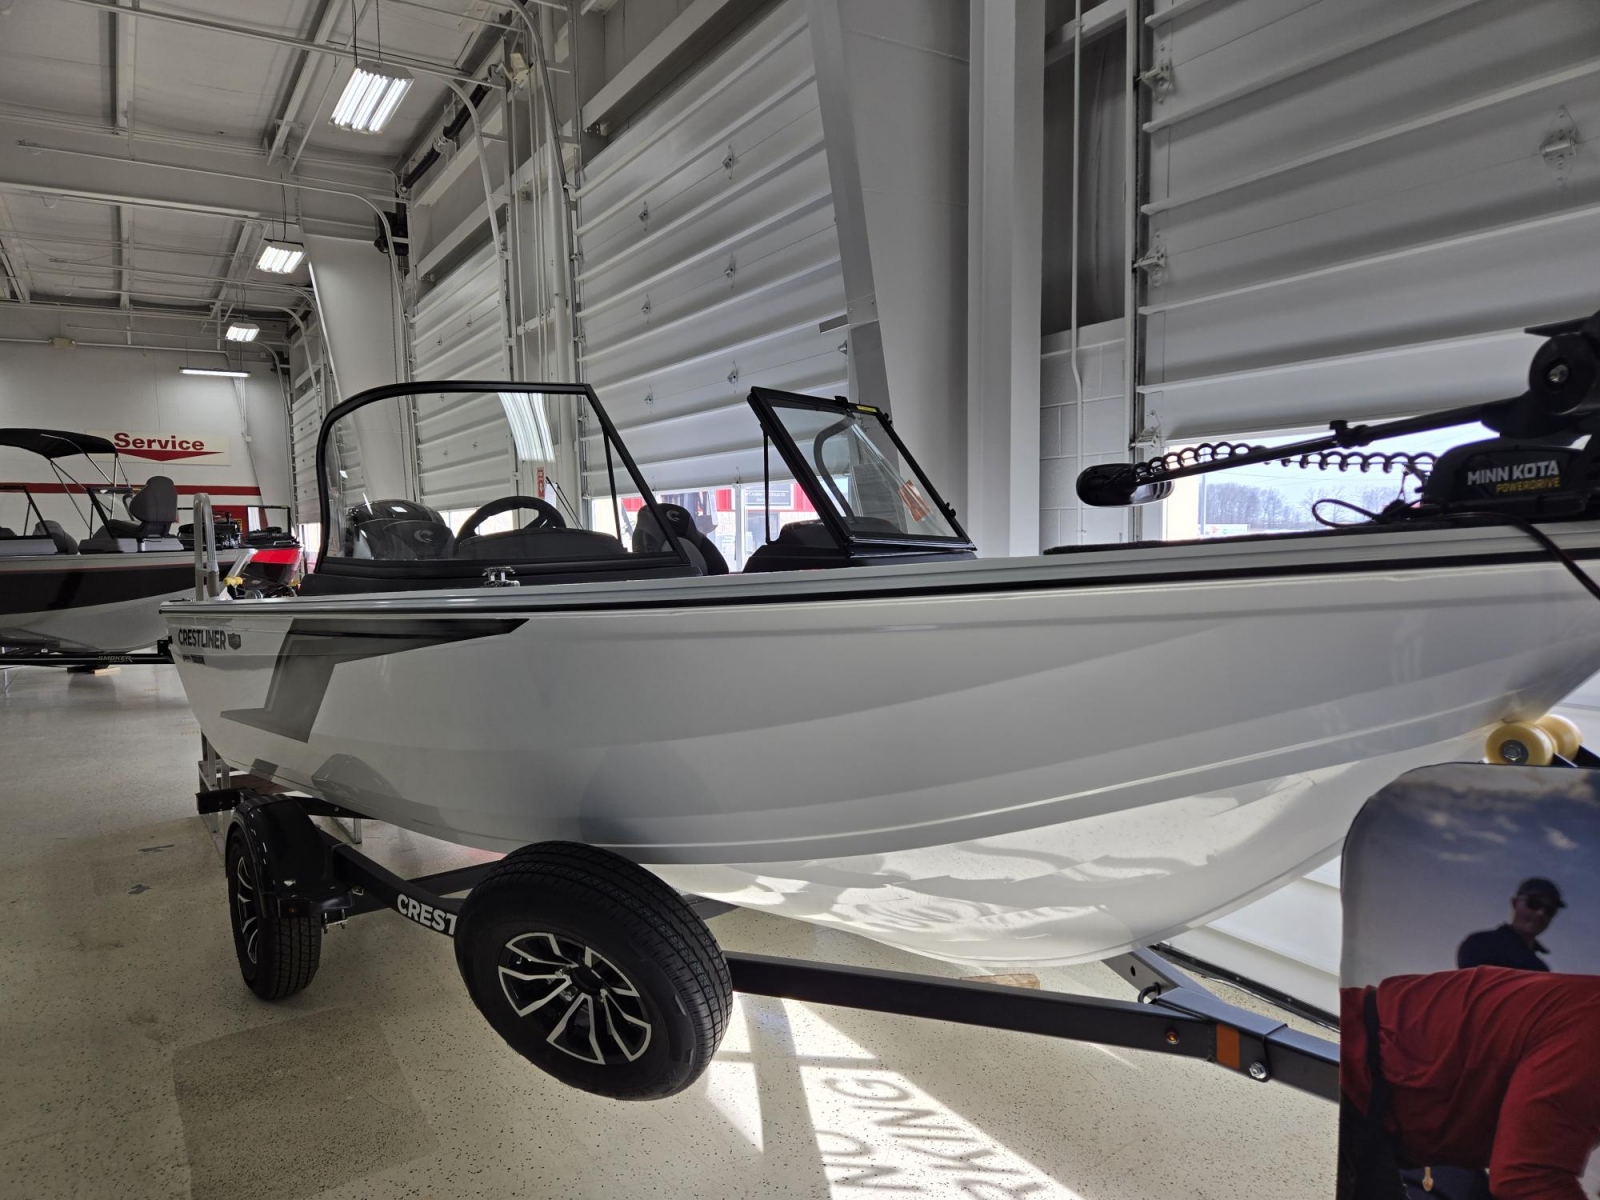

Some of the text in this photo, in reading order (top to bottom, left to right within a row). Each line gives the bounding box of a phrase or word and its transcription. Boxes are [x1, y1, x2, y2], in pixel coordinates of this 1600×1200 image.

[114, 432, 205, 451] Service
[1467, 460, 1560, 485] MINN KOTA
[1496, 477, 1561, 493] POWERDRIVE
[178, 628, 227, 650] CRESTLINER
[397, 893, 458, 936] CREST
